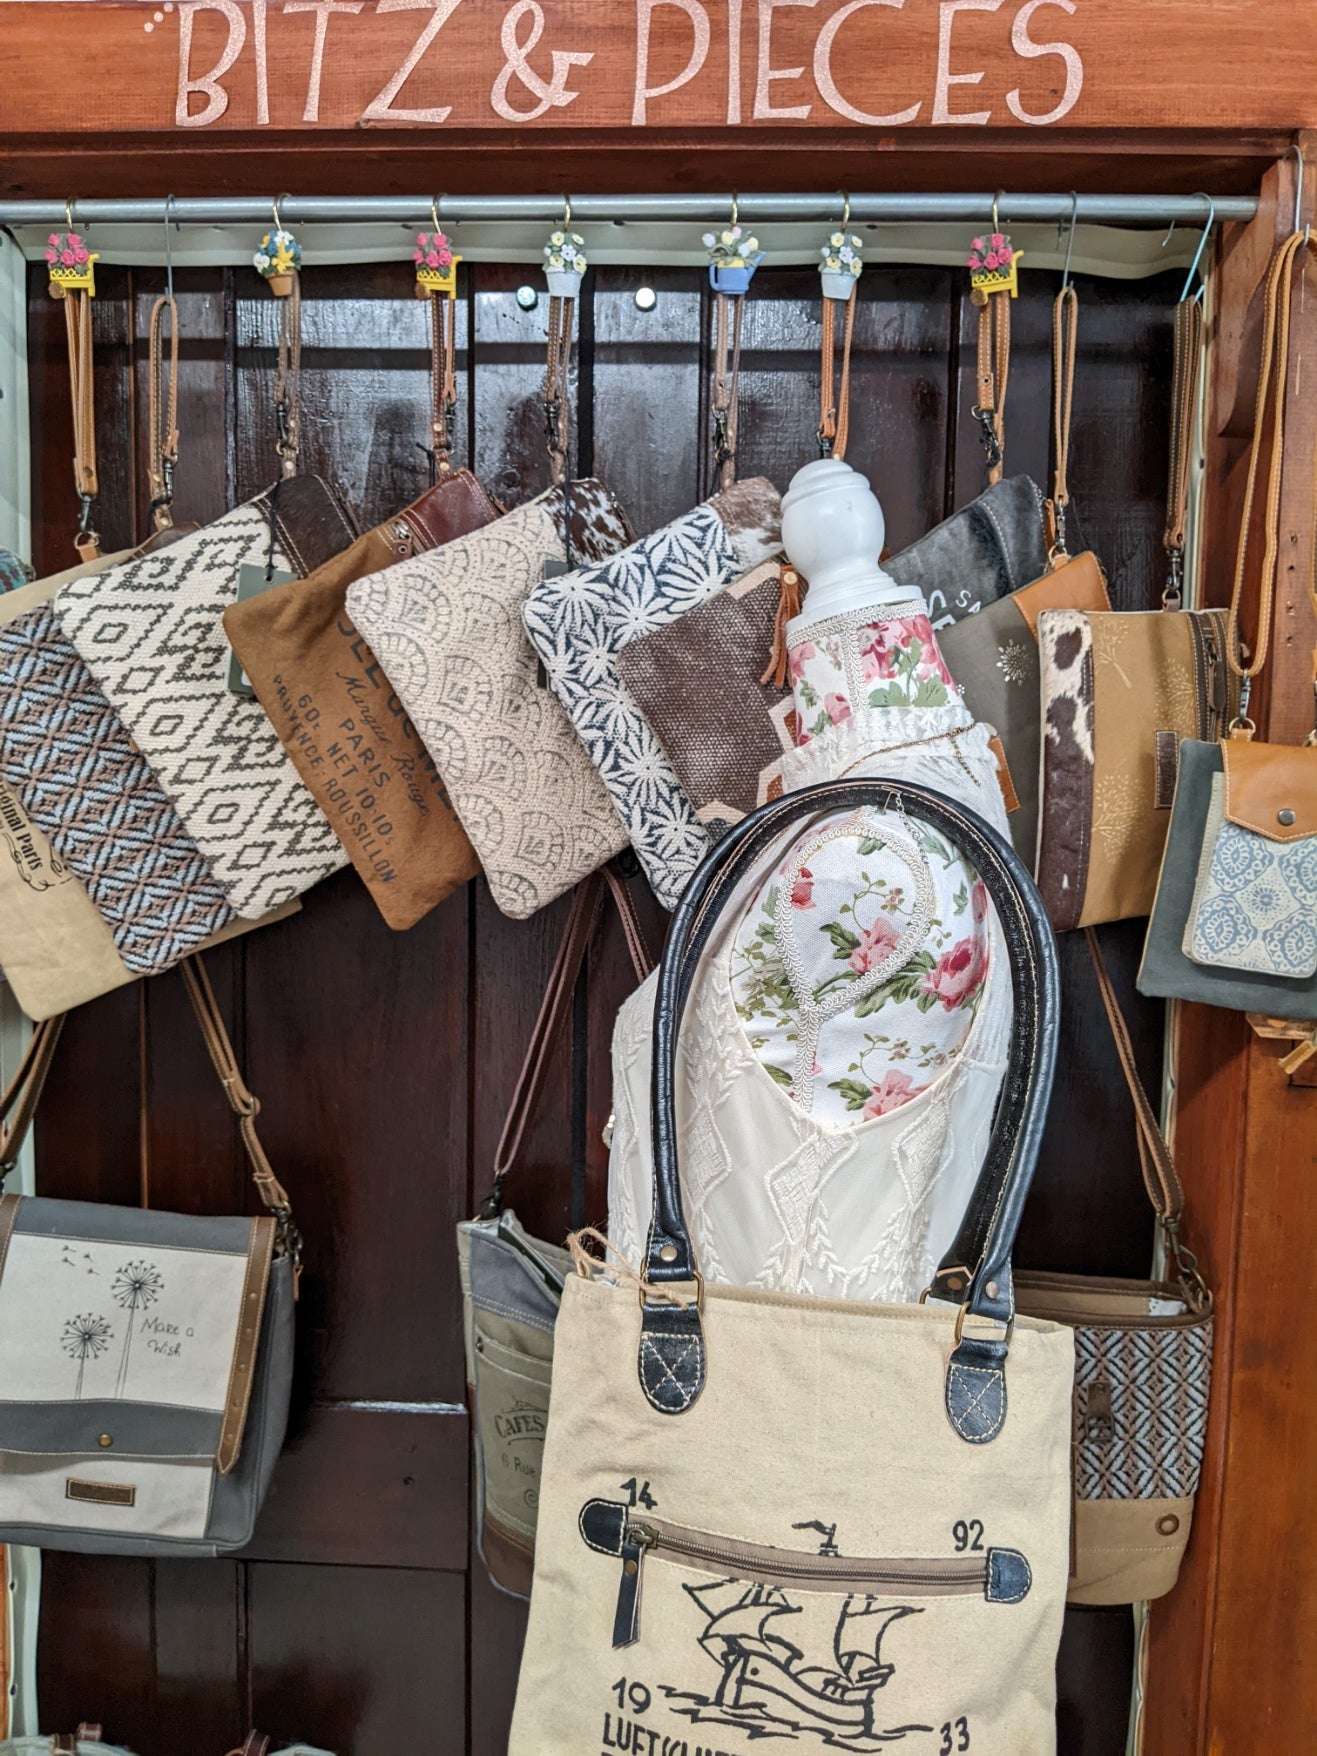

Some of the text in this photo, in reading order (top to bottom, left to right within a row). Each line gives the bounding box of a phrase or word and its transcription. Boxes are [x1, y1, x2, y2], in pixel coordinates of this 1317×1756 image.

[176, 0, 1084, 127] BITZ & PIECES
[326, 741, 359, 779] NET
[338, 717, 391, 789] PARIS
[322, 778, 399, 884] ROUSSILLON
[186, 1327, 194, 1337] a
[619, 1477, 658, 1511] 14
[952, 1518, 984, 1552] 92
[612, 1676, 651, 1714] 19
[939, 1715, 970, 1756] 33
